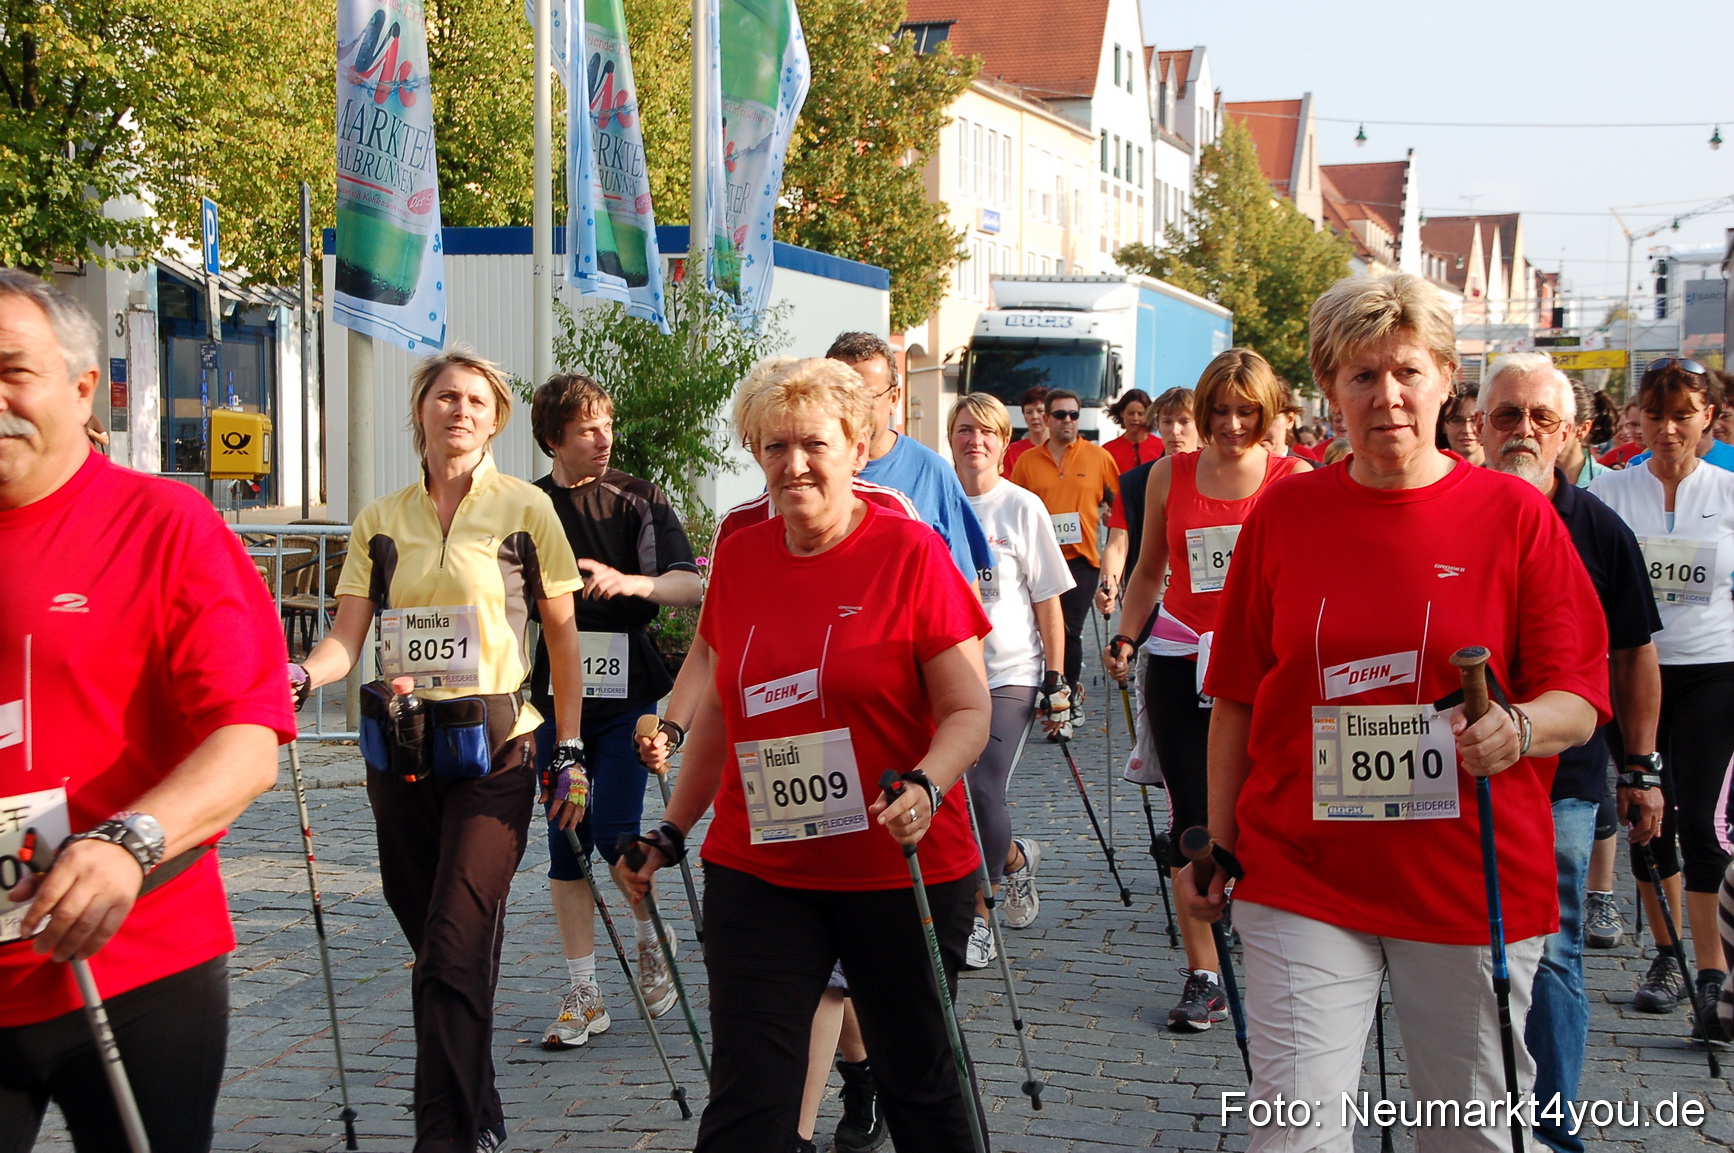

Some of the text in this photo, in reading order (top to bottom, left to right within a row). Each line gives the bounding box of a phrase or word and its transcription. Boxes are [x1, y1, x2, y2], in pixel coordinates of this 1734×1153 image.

[727, 181, 751, 214] TER
[206, 209, 215, 264] P
[115, 313, 125, 338] 3
[1005, 315, 1074, 328] BOCK
[1192, 553, 1198, 561] N
[977, 567, 992, 581] 6
[1649, 562, 1706, 583] 8106
[406, 612, 450, 629] Monika
[385, 637, 468, 662] N 8051
[583, 657, 620, 675] 128
[1348, 664, 1391, 685] DEHN
[765, 683, 798, 704] DEHN
[1347, 714, 1430, 736] Elisabeth
[764, 745, 800, 767] Heidi
[1319, 749, 1443, 781] N 8010
[747, 771, 848, 807] N 8009
[1401, 800, 1457, 813] PFLEIDERER
[818, 814, 865, 829] PFLEIDERER
